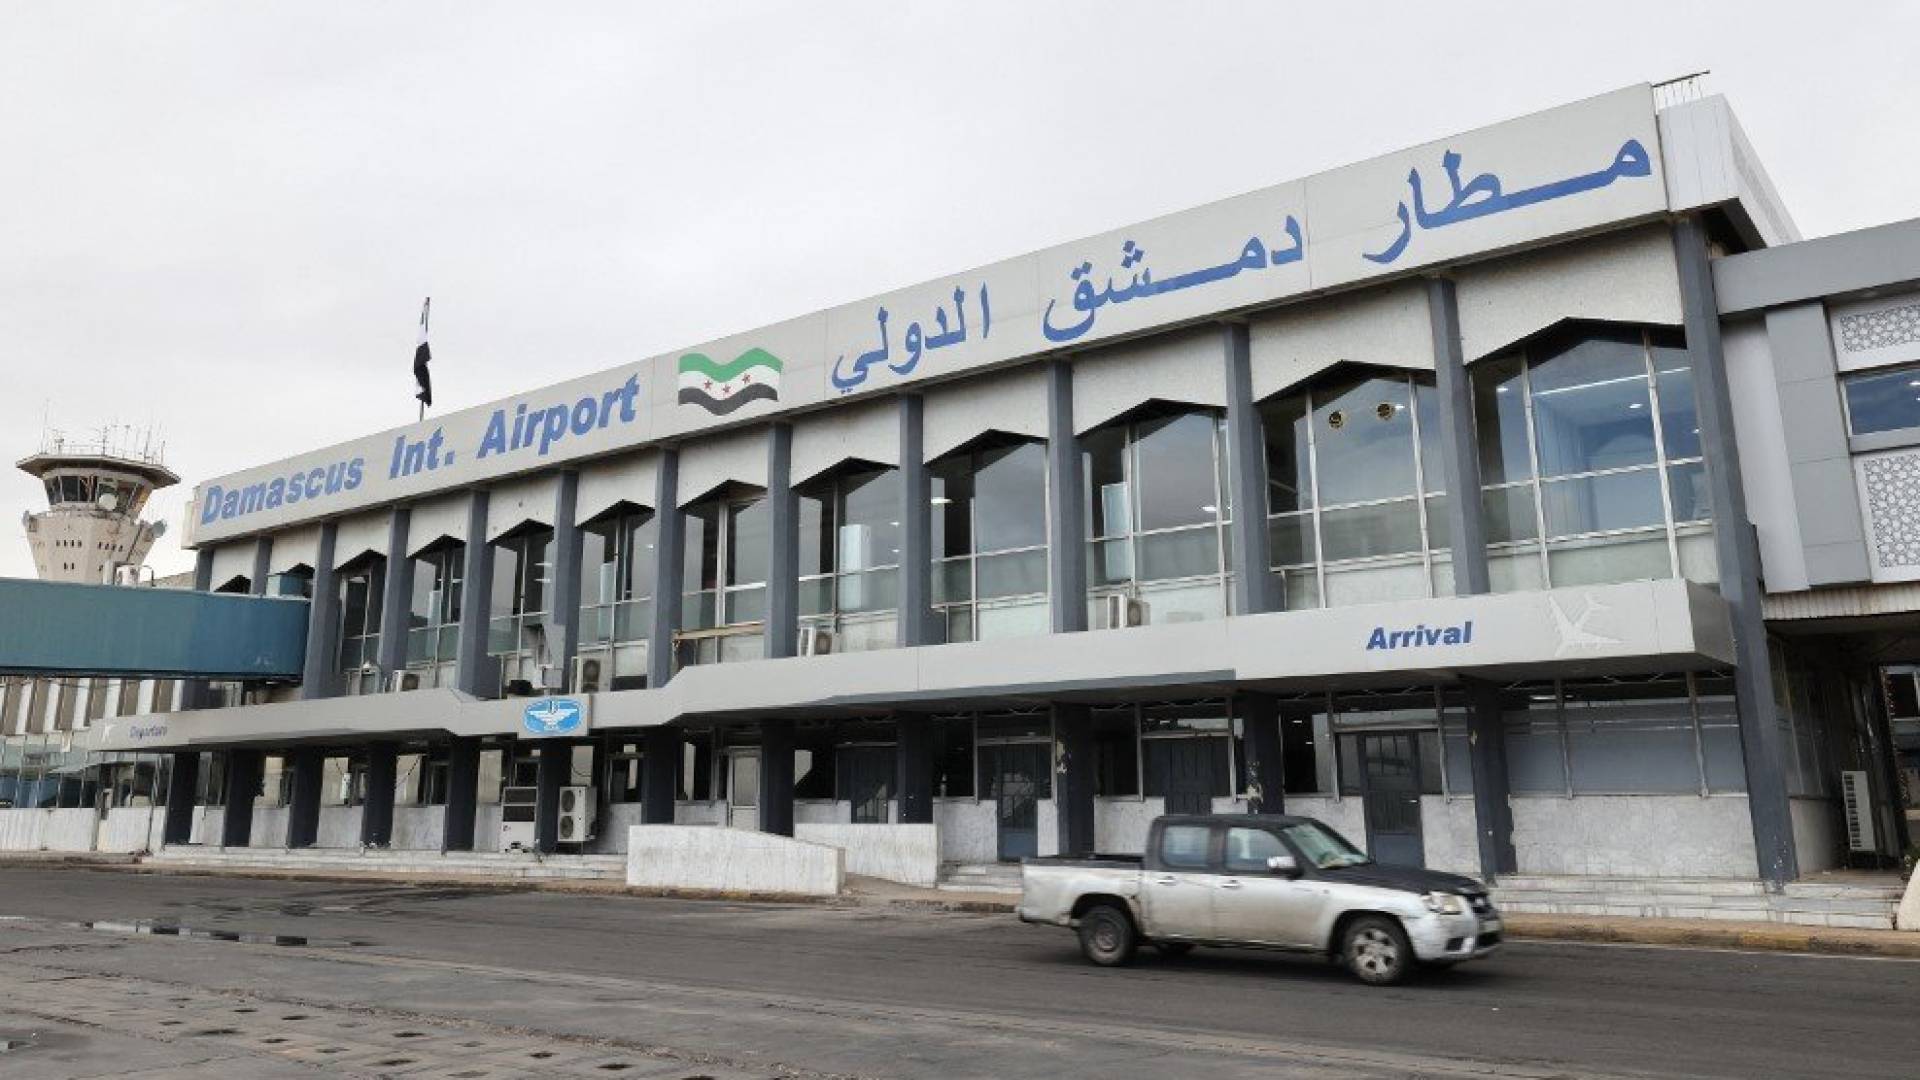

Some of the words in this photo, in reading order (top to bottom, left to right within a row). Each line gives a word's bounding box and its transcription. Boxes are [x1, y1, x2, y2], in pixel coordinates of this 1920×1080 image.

[1362, 139, 1652, 264] مطار
[832, 282, 991, 394] الدولي
[1042, 215, 1304, 342] دمشق
[202, 456, 363, 524] Damascus
[389, 426, 455, 479] Int.
[477, 374, 639, 456] Airport
[1367, 620, 1472, 650] Arrival
